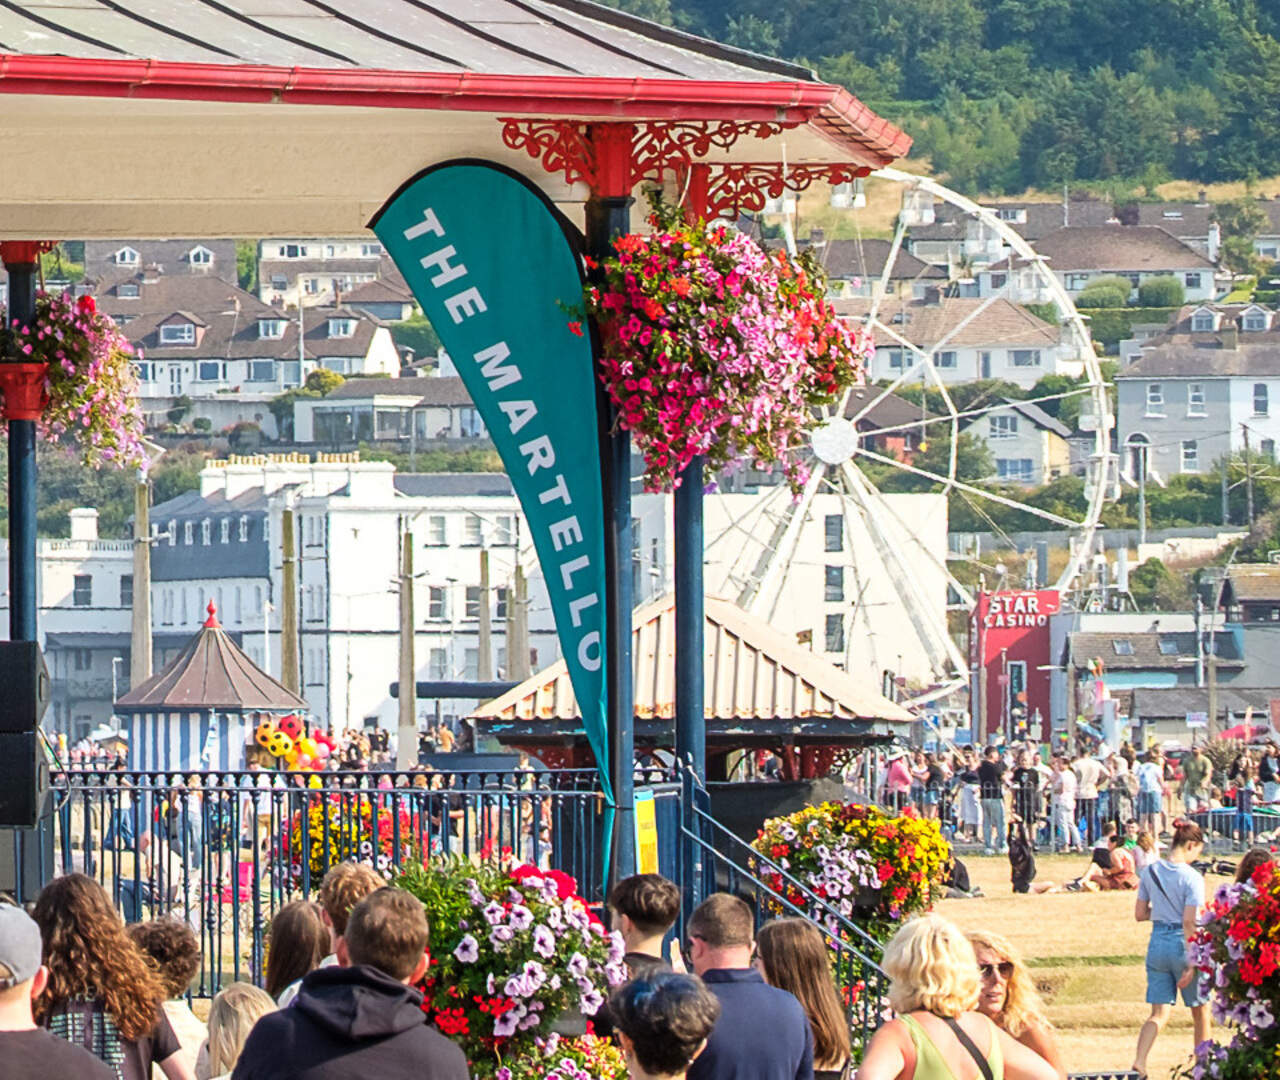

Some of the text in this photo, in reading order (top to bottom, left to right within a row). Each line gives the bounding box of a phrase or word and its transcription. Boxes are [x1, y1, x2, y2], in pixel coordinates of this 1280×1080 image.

[403, 207, 602, 672] THE MARTELLO
[990, 597, 1039, 614] STAR
[984, 614, 1047, 628] CASINO
